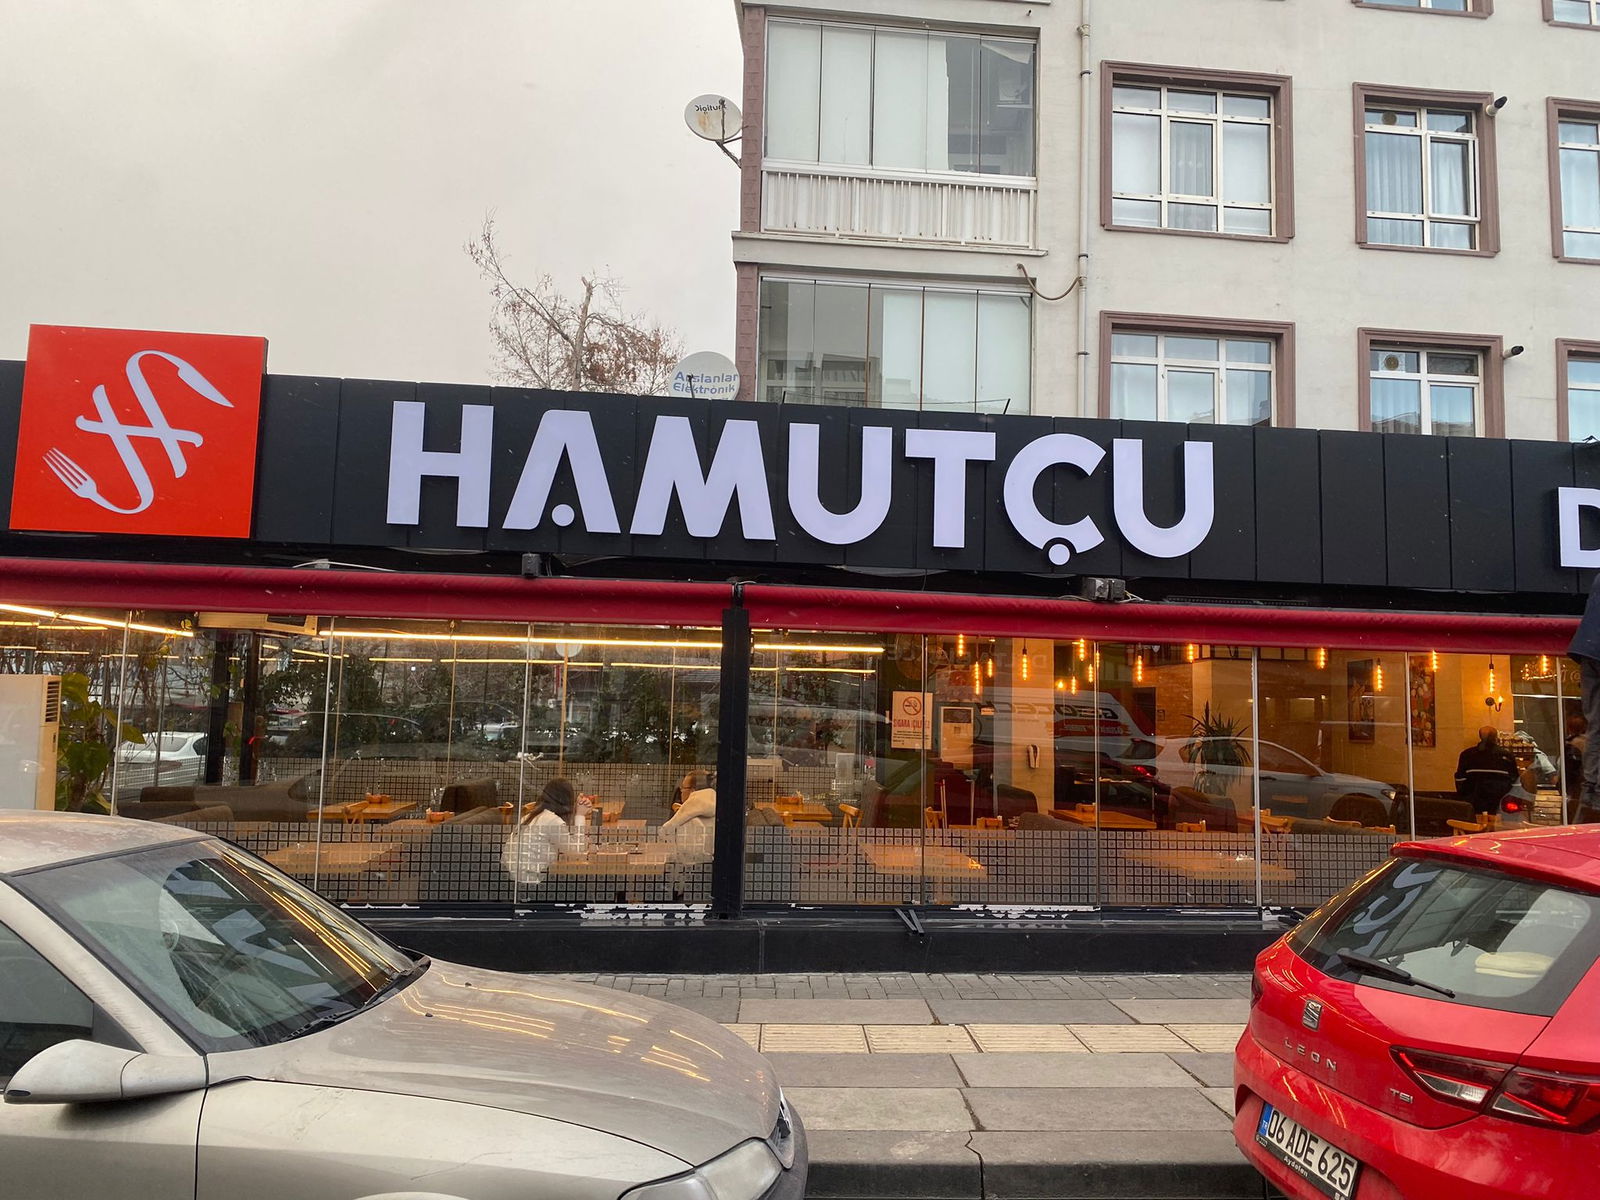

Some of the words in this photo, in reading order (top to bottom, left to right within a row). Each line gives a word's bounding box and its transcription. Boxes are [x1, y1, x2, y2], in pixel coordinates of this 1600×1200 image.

[386, 401, 1215, 565] HAMUTÇU
[1284, 1038, 1337, 1071] LEON
[1389, 1087, 1414, 1104] TSI
[1267, 1109, 1284, 1144] 06
[1285, 1123, 1318, 1167] ADE
[1318, 1147, 1353, 1190] 625
